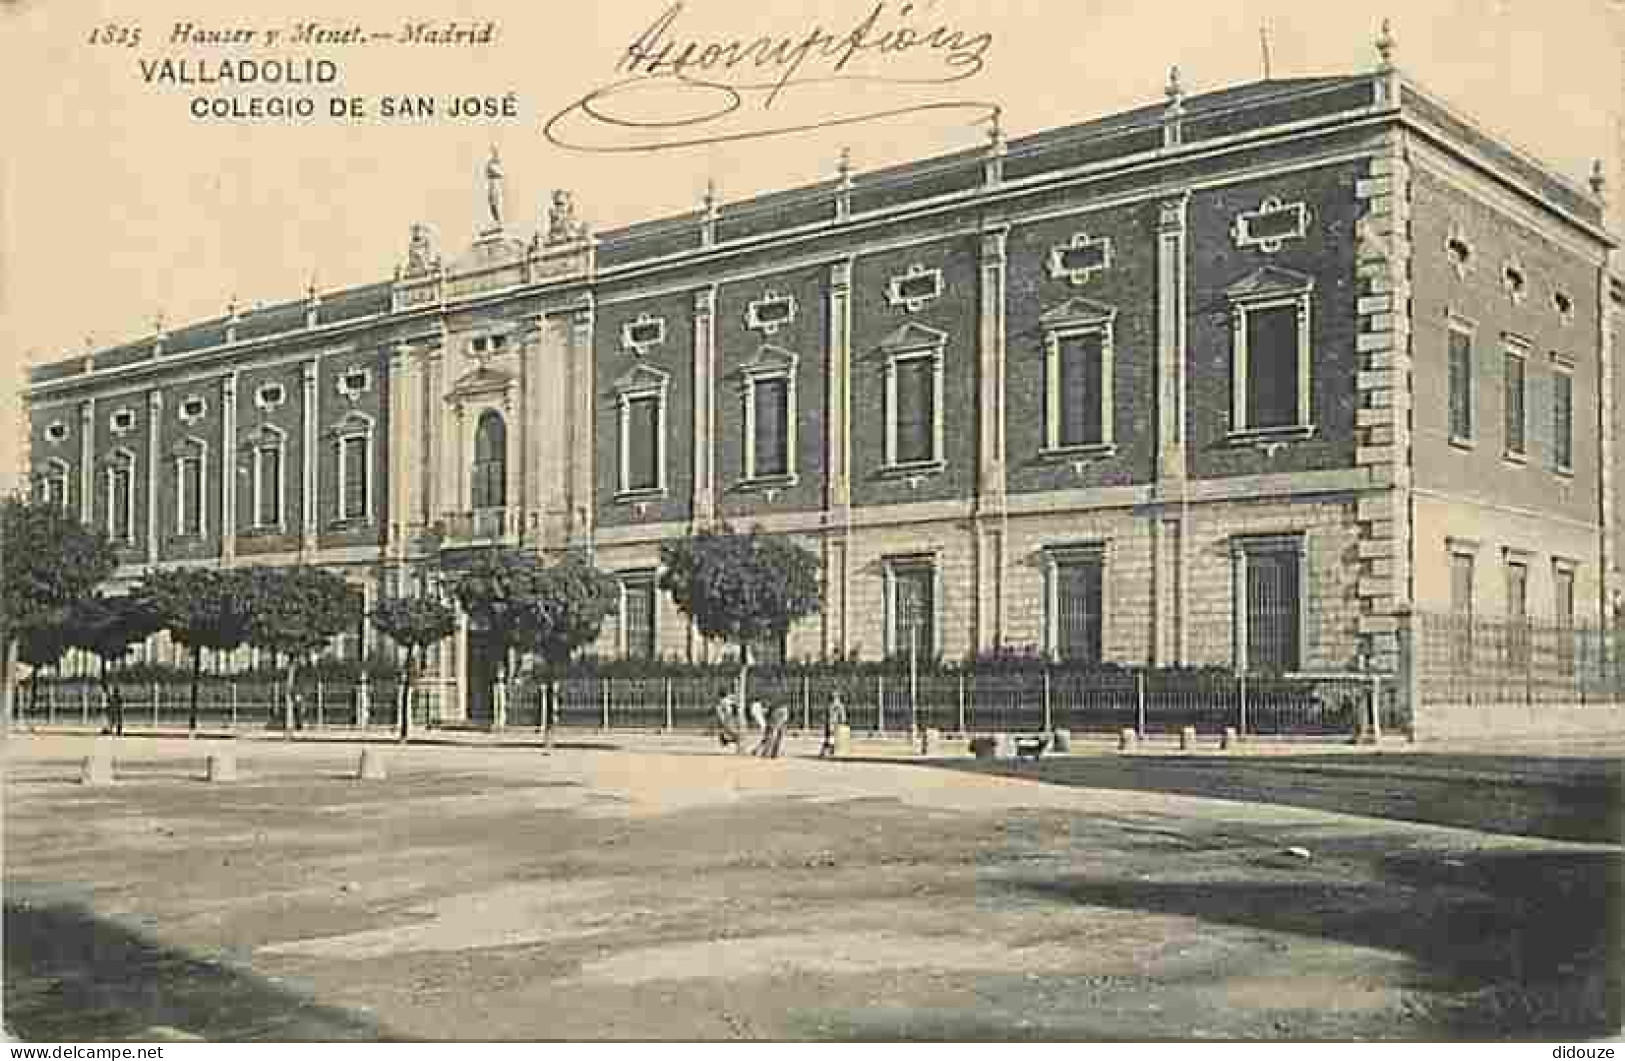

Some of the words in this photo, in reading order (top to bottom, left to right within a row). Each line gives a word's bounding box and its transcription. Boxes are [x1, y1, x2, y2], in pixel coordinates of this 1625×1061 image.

[168, 22, 258, 45] Hauser
[139, 58, 337, 84] VALLADOLID
[190, 97, 315, 118] COLEGIO
[329, 97, 364, 118] DE
[380, 97, 435, 118] SAN
[448, 91, 518, 118] JOSÉ
